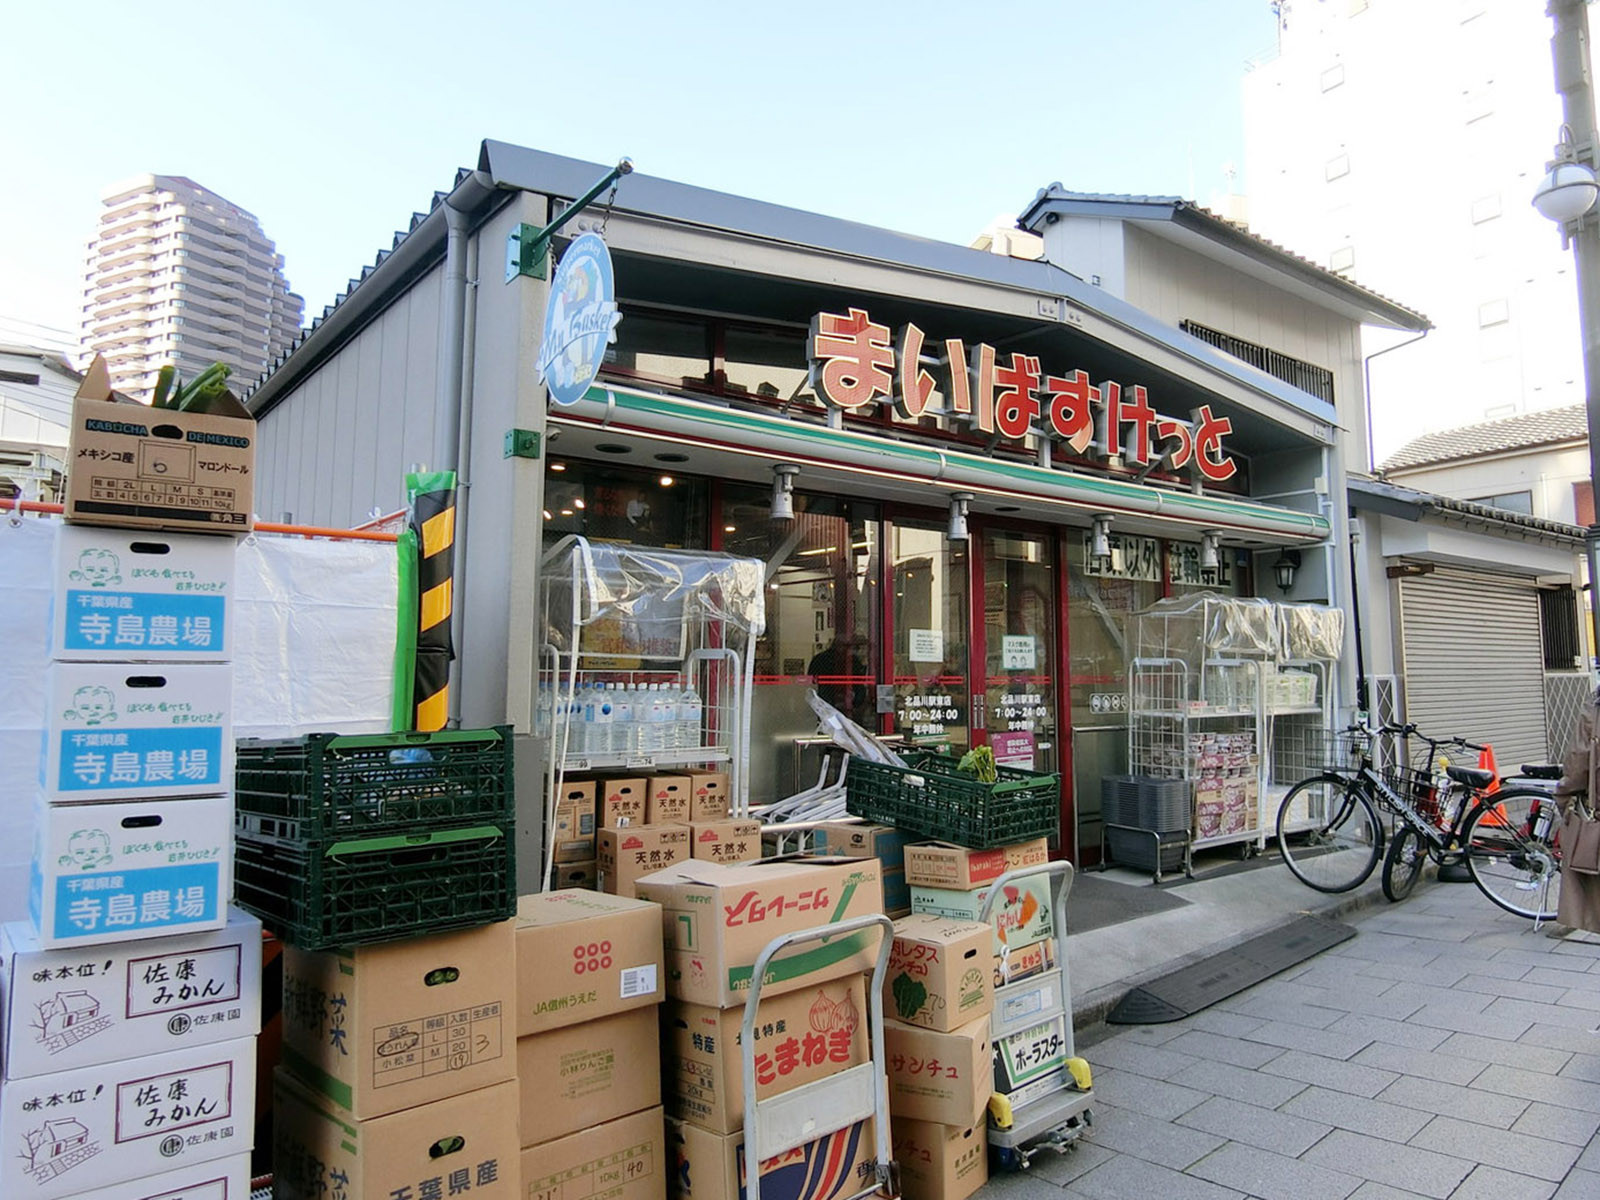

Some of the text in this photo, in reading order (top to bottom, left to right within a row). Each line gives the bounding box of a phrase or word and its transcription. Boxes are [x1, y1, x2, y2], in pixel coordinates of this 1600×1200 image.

[812, 307, 1238, 481] まいばすけっと
[206, 433, 250, 449] MEXICO
[77, 447, 135, 464] メキシコ産
[197, 460, 249, 475] マロンドール
[77, 594, 133, 608] 千葉県産
[79, 613, 212, 646] 寺島農場
[71, 733, 129, 746] 千葉県産
[73, 749, 209, 785] 寺島農場
[611, 800, 641, 812] 天然水
[659, 799, 687, 808] 天然水
[699, 795, 726, 804] 天然水
[635, 848, 675, 864] 天然水
[711, 841, 748, 856] 天然水
[66, 875, 124, 892] 千葉県産
[68, 886, 205, 930] 寺島農場
[724, 887, 829, 927] サニーレタス
[142, 958, 197, 984] 佐康
[152, 978, 225, 1005] みかん
[533, 990, 598, 1016] JA信州うえだ
[194, 1008, 241, 1026] 佐康園
[450, 1012, 468, 1024] 入数
[473, 1005, 498, 1019] 生産者
[432, 1034, 439, 1042] L
[452, 1027, 466, 1038] 30
[452, 1042, 466, 1052] 20
[754, 1024, 853, 1086] たまねぎ
[1015, 1034, 1064, 1071] ポーラスター
[382, 1053, 414, 1069] 小松菜
[890, 1054, 958, 1079] サンチュ
[134, 1078, 189, 1105] 佐康
[144, 1097, 219, 1127] みかん
[186, 1126, 234, 1146] 佐康園
[626, 1160, 644, 1178] 40
[389, 1158, 498, 1200] 千葉県産
